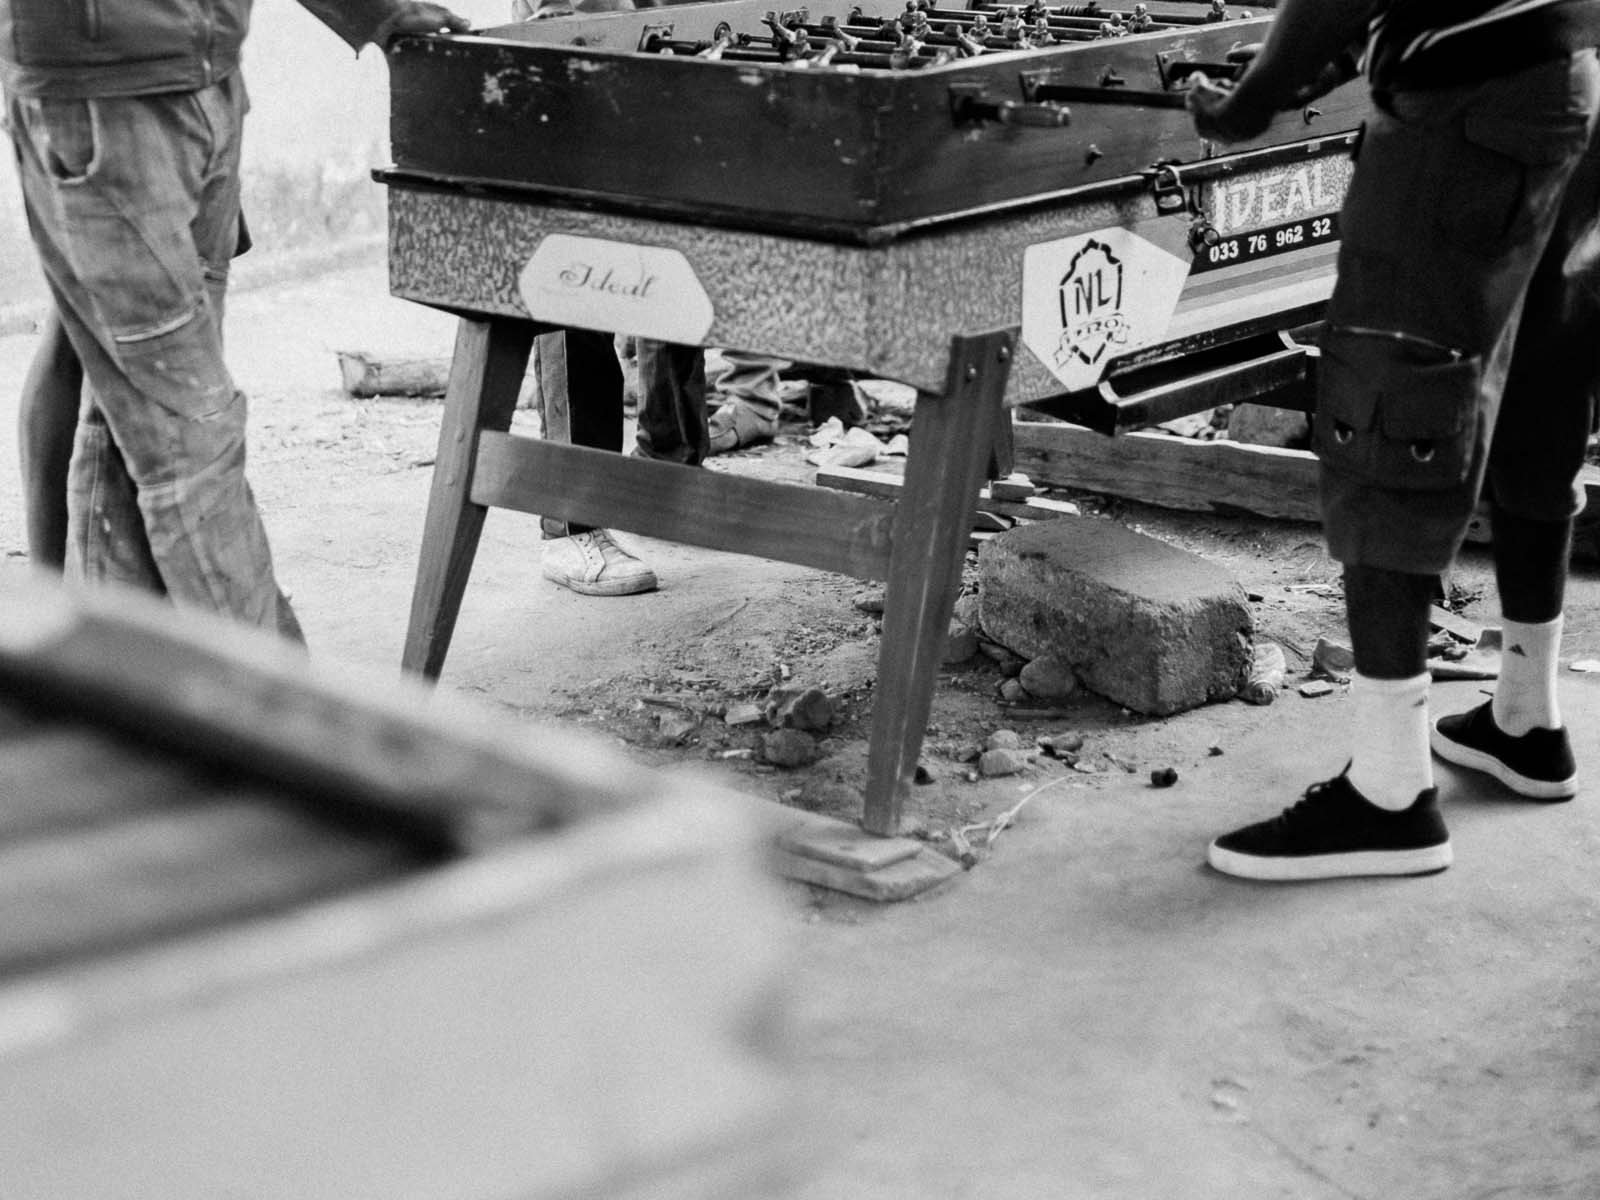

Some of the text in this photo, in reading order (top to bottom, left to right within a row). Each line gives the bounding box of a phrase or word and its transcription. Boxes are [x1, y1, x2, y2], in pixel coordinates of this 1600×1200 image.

[1212, 162, 1332, 236] IDEAL
[1209, 217, 1331, 263] 033 76 962 32
[559, 264, 655, 298] Ideal
[1074, 268, 1113, 315] NL
